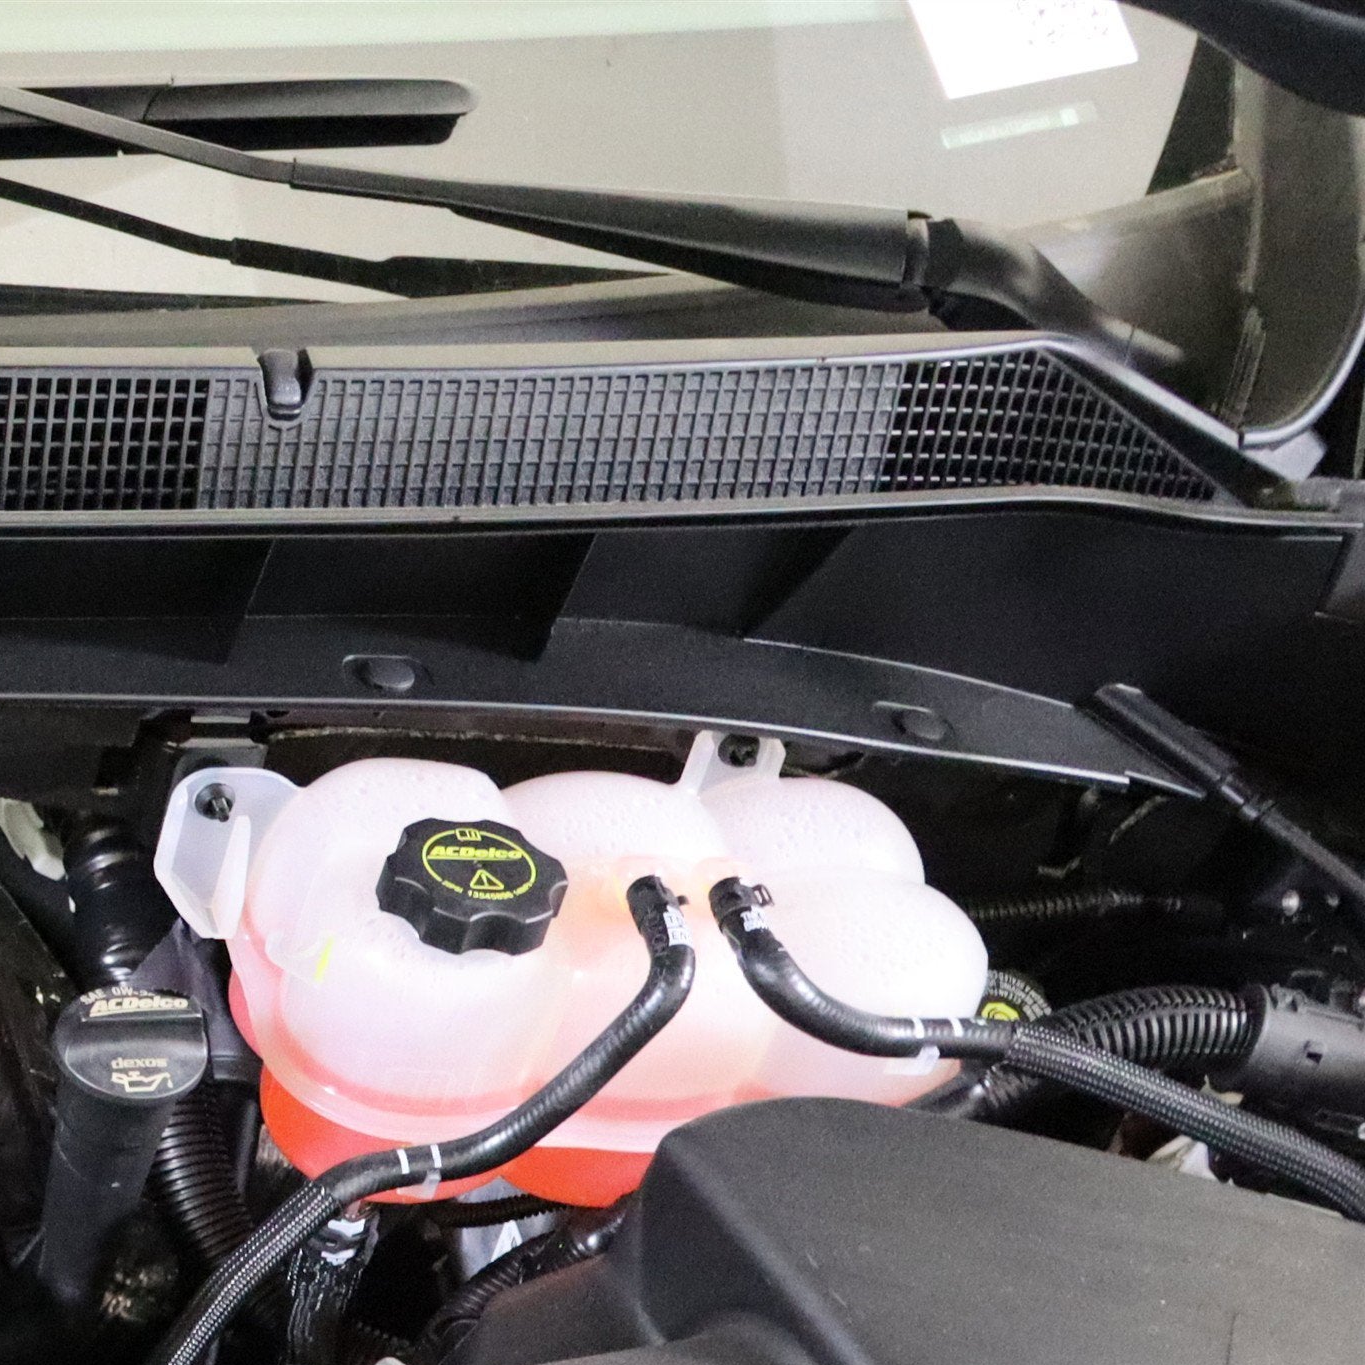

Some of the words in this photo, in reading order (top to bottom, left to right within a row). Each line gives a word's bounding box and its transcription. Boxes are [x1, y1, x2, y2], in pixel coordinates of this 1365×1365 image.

[427, 846, 523, 860] ACDelco
[79, 988, 106, 1005] SAE
[89, 996, 188, 1017] ACDelco
[111, 1057, 167, 1069] dexos
